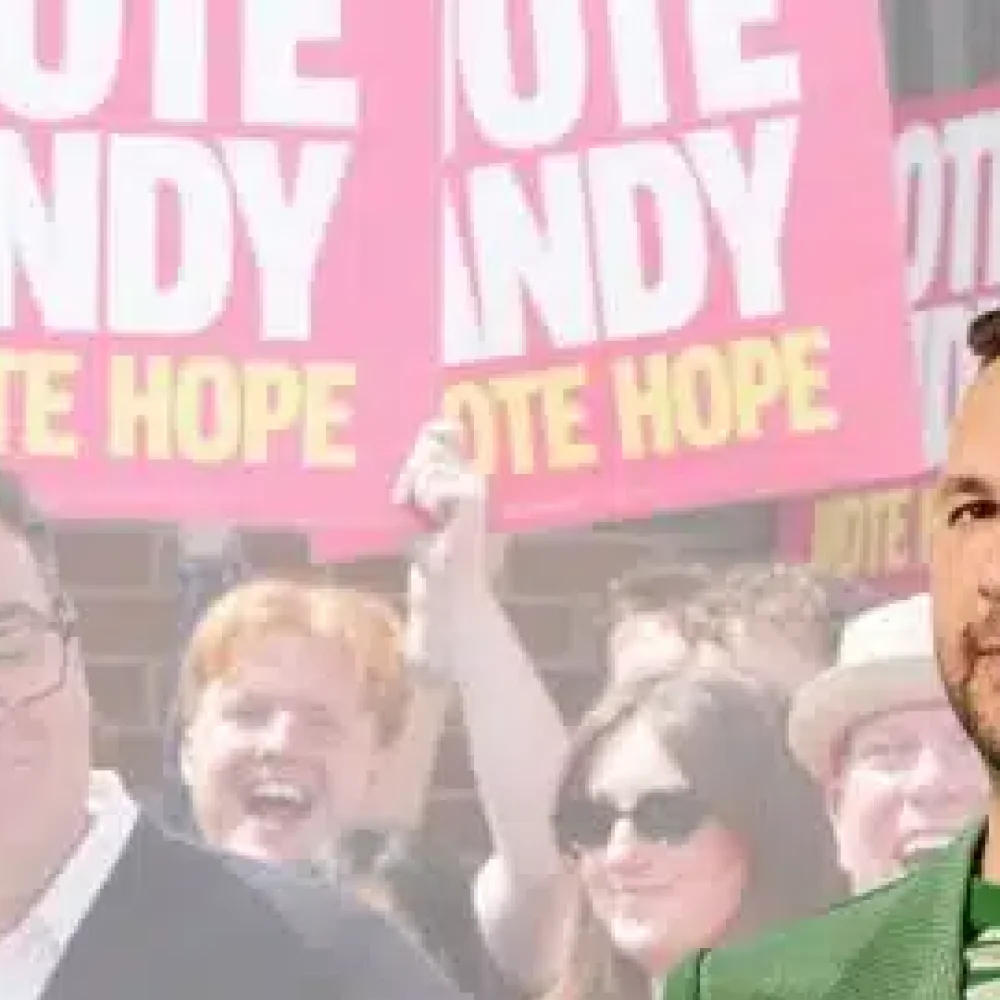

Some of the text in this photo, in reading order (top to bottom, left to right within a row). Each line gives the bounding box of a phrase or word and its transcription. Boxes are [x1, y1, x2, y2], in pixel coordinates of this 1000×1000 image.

[443, 0, 802, 156] OTE
[443, 114, 800, 365] NDY
[107, 353, 358, 468] HOPE
[611, 326, 839, 460] HOPE
